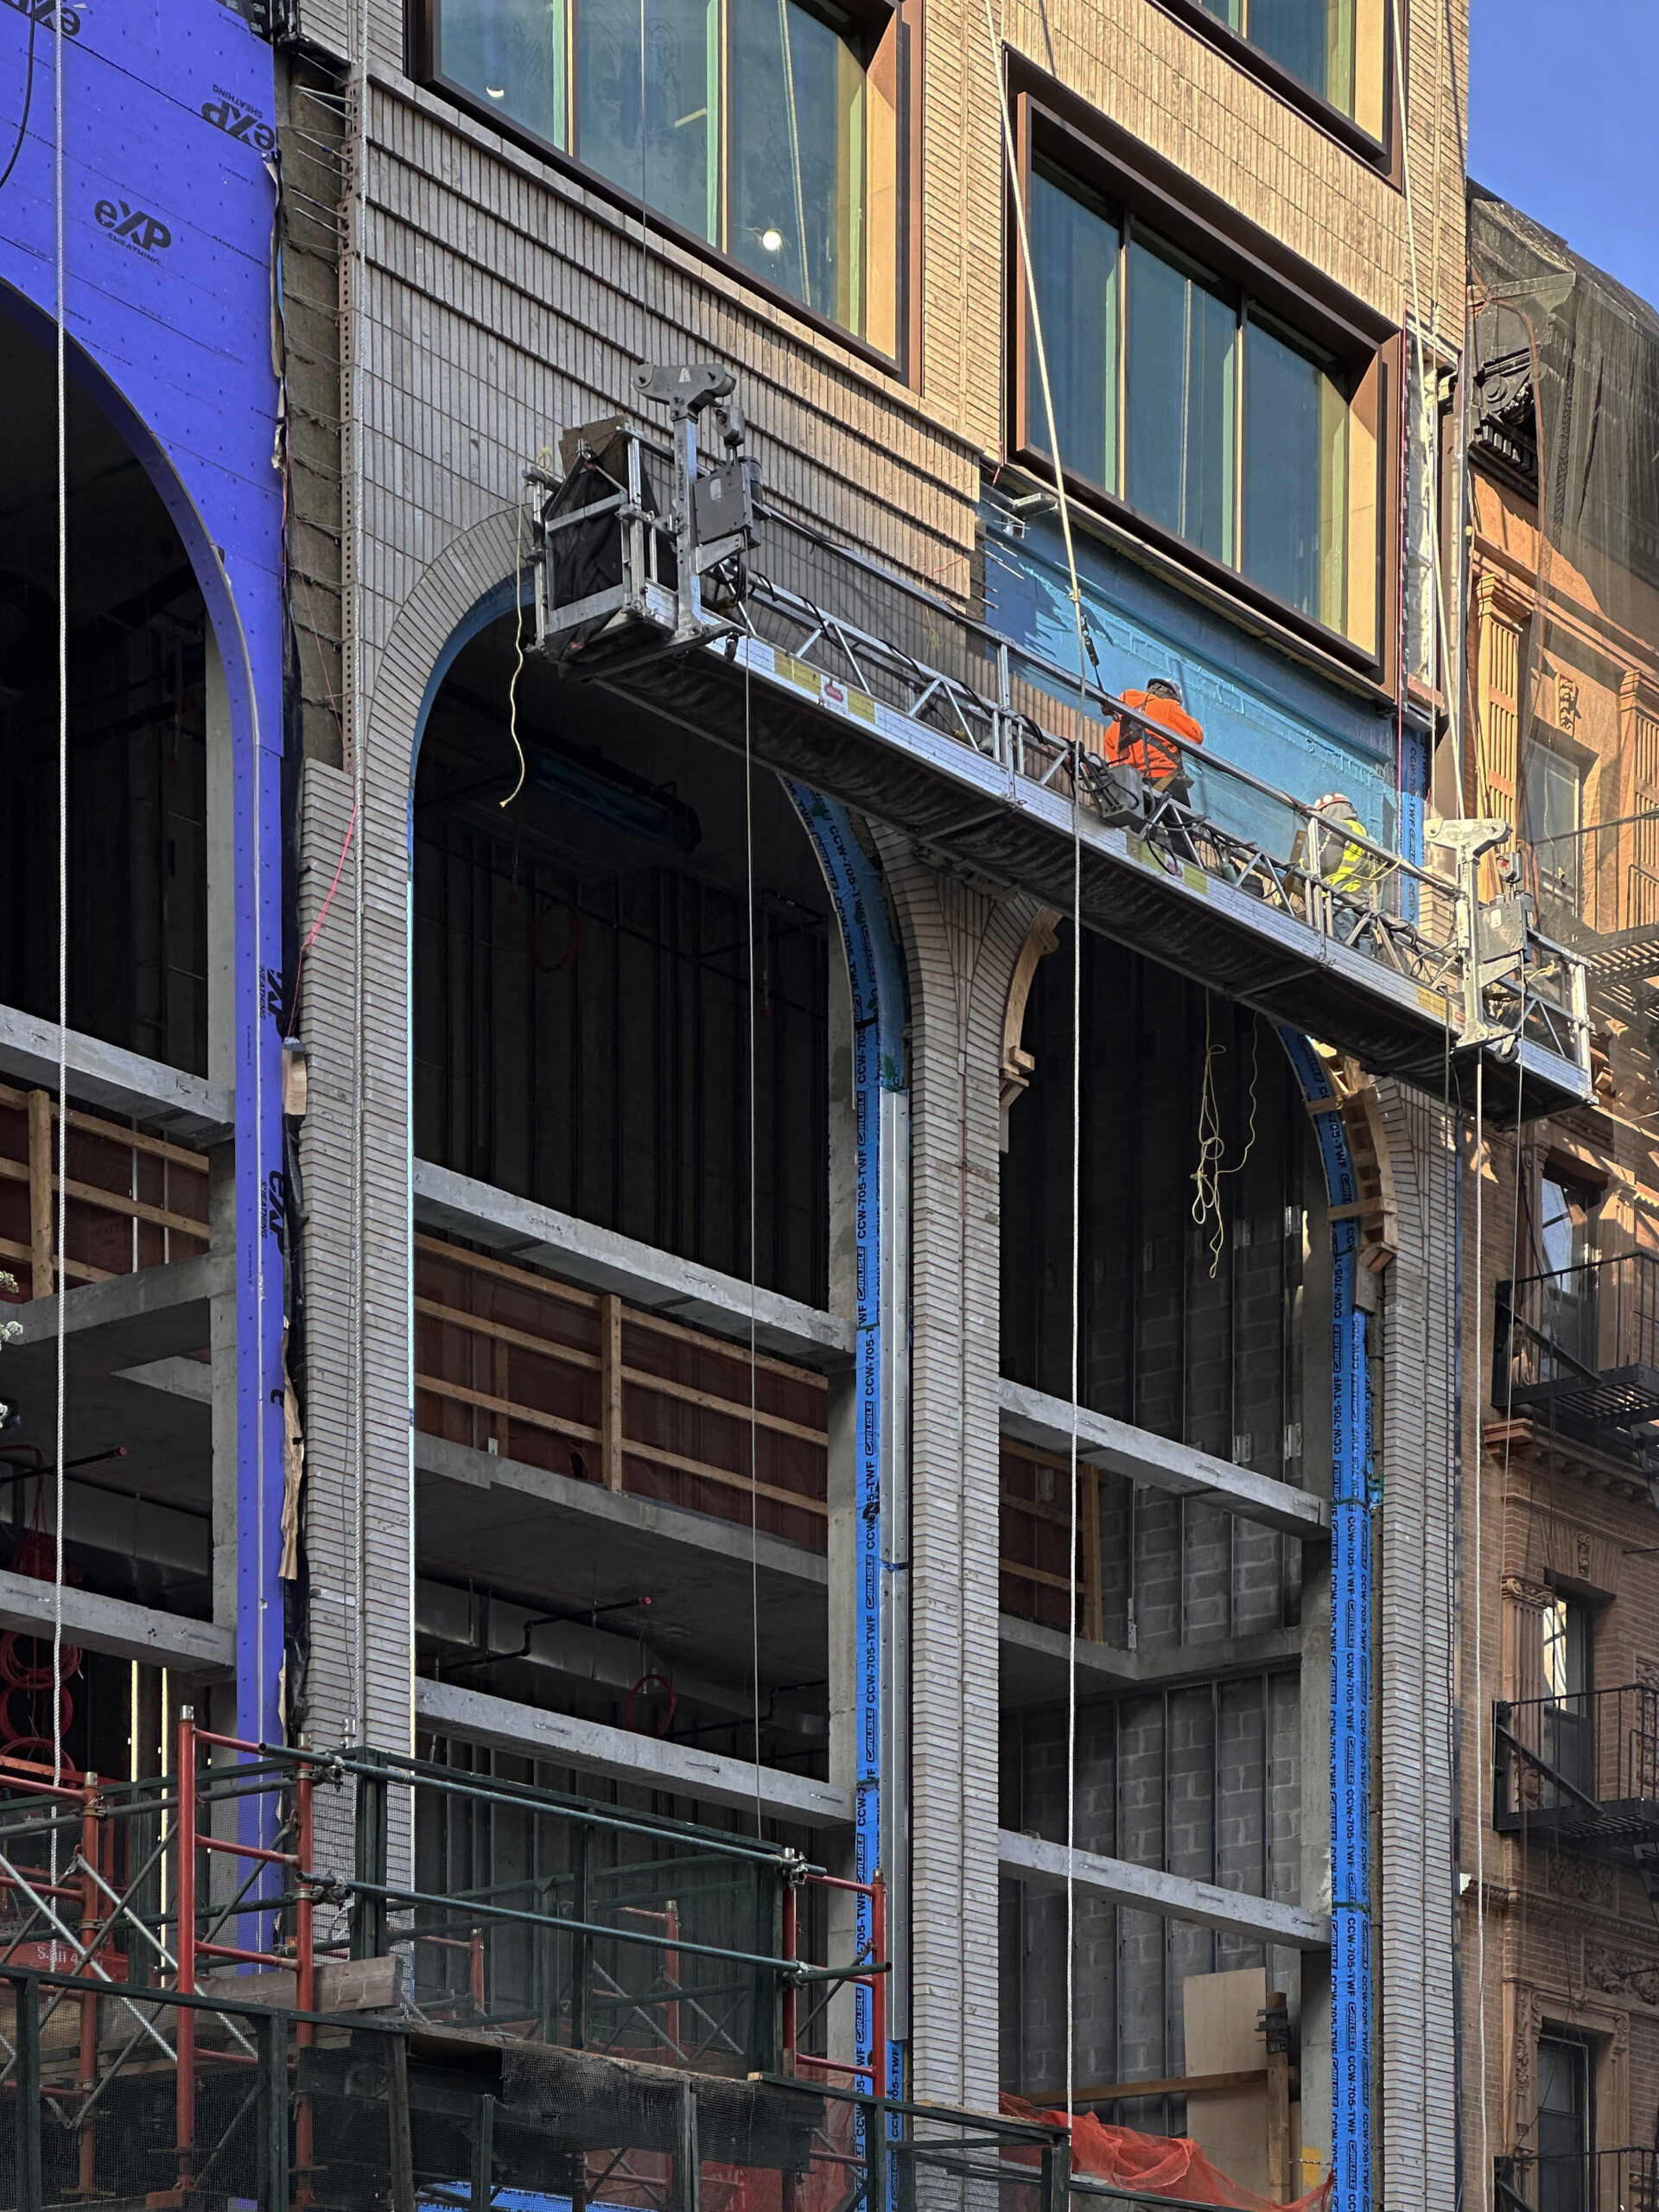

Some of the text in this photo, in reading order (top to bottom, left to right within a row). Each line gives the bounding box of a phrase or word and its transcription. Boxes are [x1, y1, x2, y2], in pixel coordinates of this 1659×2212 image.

[201, 101, 276, 152] eXP
[213, 84, 263, 119] SHEATHING
[94, 199, 172, 251] eXP
[856, 1090, 866, 1147] CARLISLE
[857, 1151, 868, 1240] CCW-705-TWF
[856, 1246, 867, 1302] CARLISLE
[1332, 1324, 1342, 1373] CARLISLE
[865, 1401, 874, 1456] CARLISLE
[1333, 1376, 1343, 1455] CCW-705-TWF
[866, 1461, 875, 1550] CCW5-TWF
[865, 1554, 875, 1611] CARLISLE
[1347, 1516, 1356, 1595] CCW-705-TWF
[866, 1615, 876, 1704] CCW-705-TWF
[1346, 1652, 1355, 1733] CCW-705-TWF
[866, 1707, 875, 1764] CARLISLE
[1346, 1735, 1356, 1786] CARLISLE
[1346, 1789, 1355, 1868] CCW-705-TWF
[1347, 1917, 1356, 1997] CCW-705-TWF
[855, 1987, 865, 2044] CARLISLE
[1348, 2001, 1357, 2052] CARLISLE
[1348, 2055, 1357, 2136] CCW-705-TWF
[1348, 2139, 1357, 2190] CARLISLE
